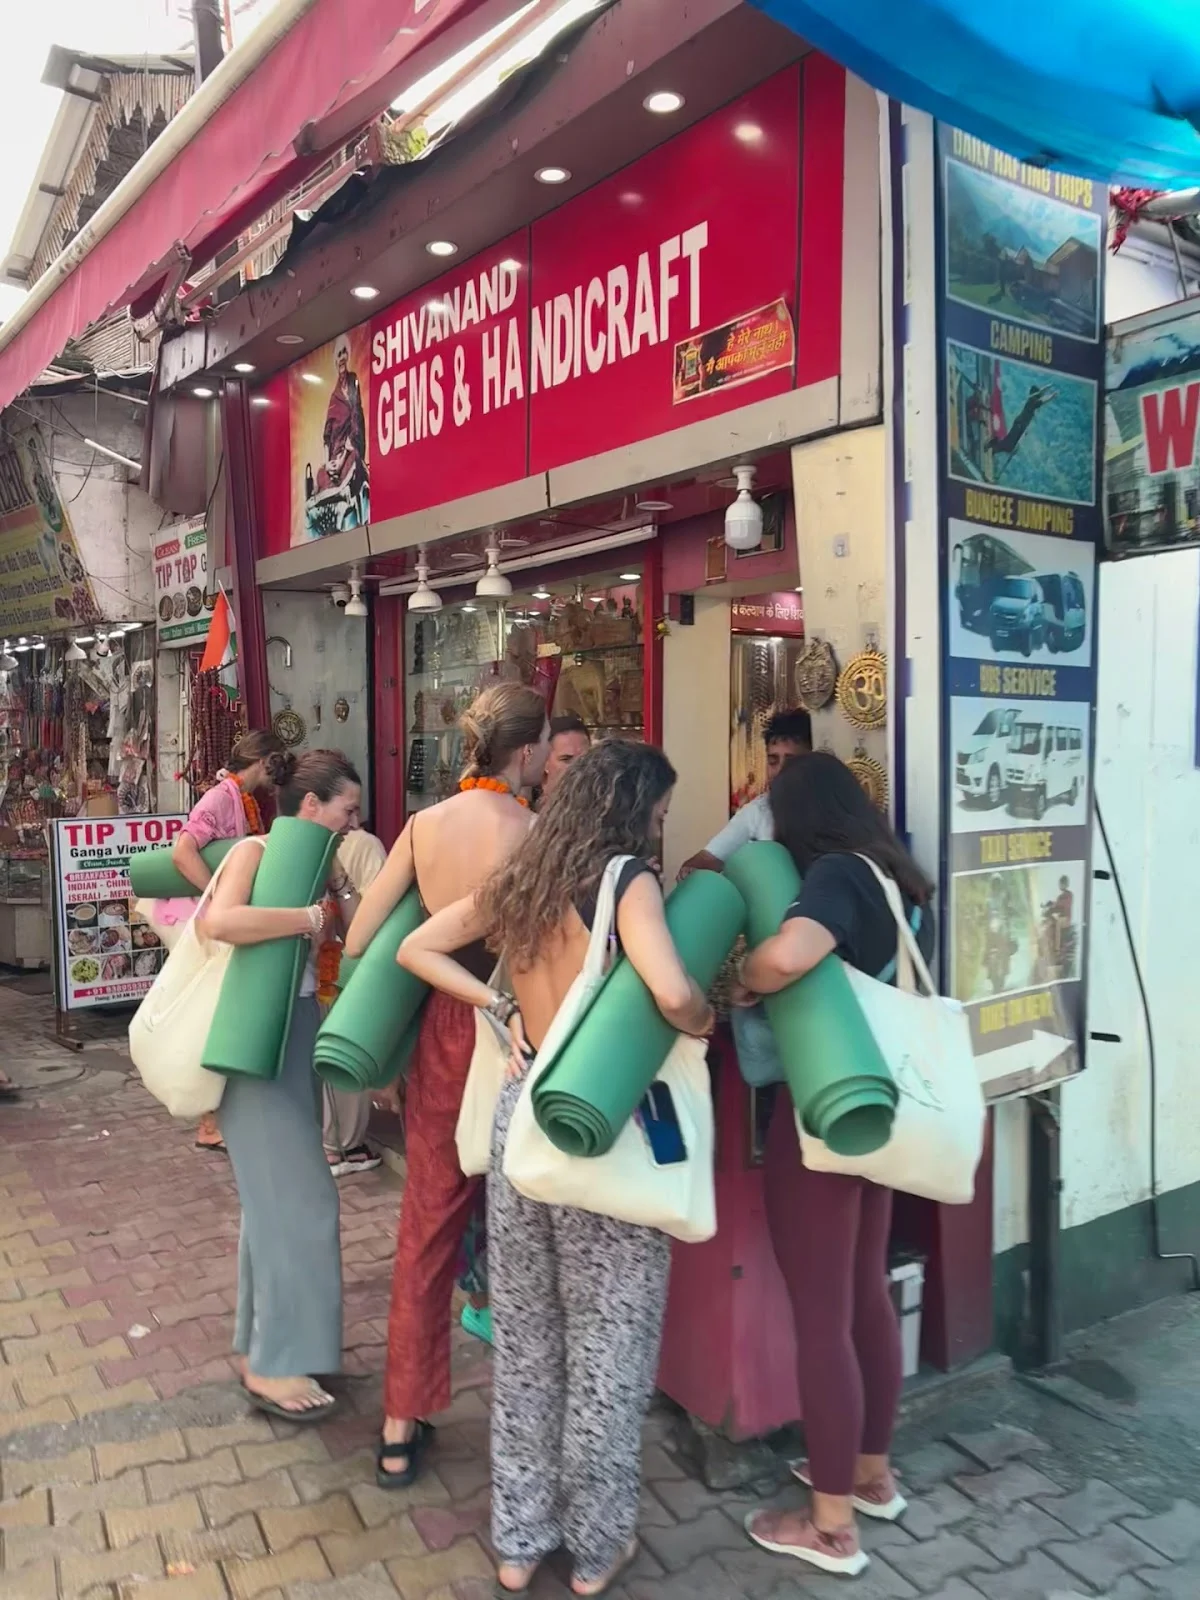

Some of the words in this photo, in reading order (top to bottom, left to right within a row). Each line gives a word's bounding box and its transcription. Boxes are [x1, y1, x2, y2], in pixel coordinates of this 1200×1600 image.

[953, 128, 991, 169] DAILY
[1055, 171, 1093, 209] TRIPS
[372, 262, 519, 376] SHIVANAND
[989, 318, 1053, 365] CAMPING
[377, 353, 445, 457] GEMS
[452, 344, 472, 428] &
[965, 488, 1014, 525] BUNGEE
[1017, 499, 1074, 535] JUMPING
[155, 561, 173, 589] TIP
[174, 554, 198, 584] TOP
[1002, 668, 1057, 696] SERVICE
[64, 823, 115, 847] TIP
[126, 819, 183, 844] TOP
[70, 847, 112, 859] Ganga
[116, 844, 148, 856] View
[67, 882, 97, 891] INDIAN
[69, 870, 113, 881] BREAKFAST
[68, 892, 101, 902] ISERALI
